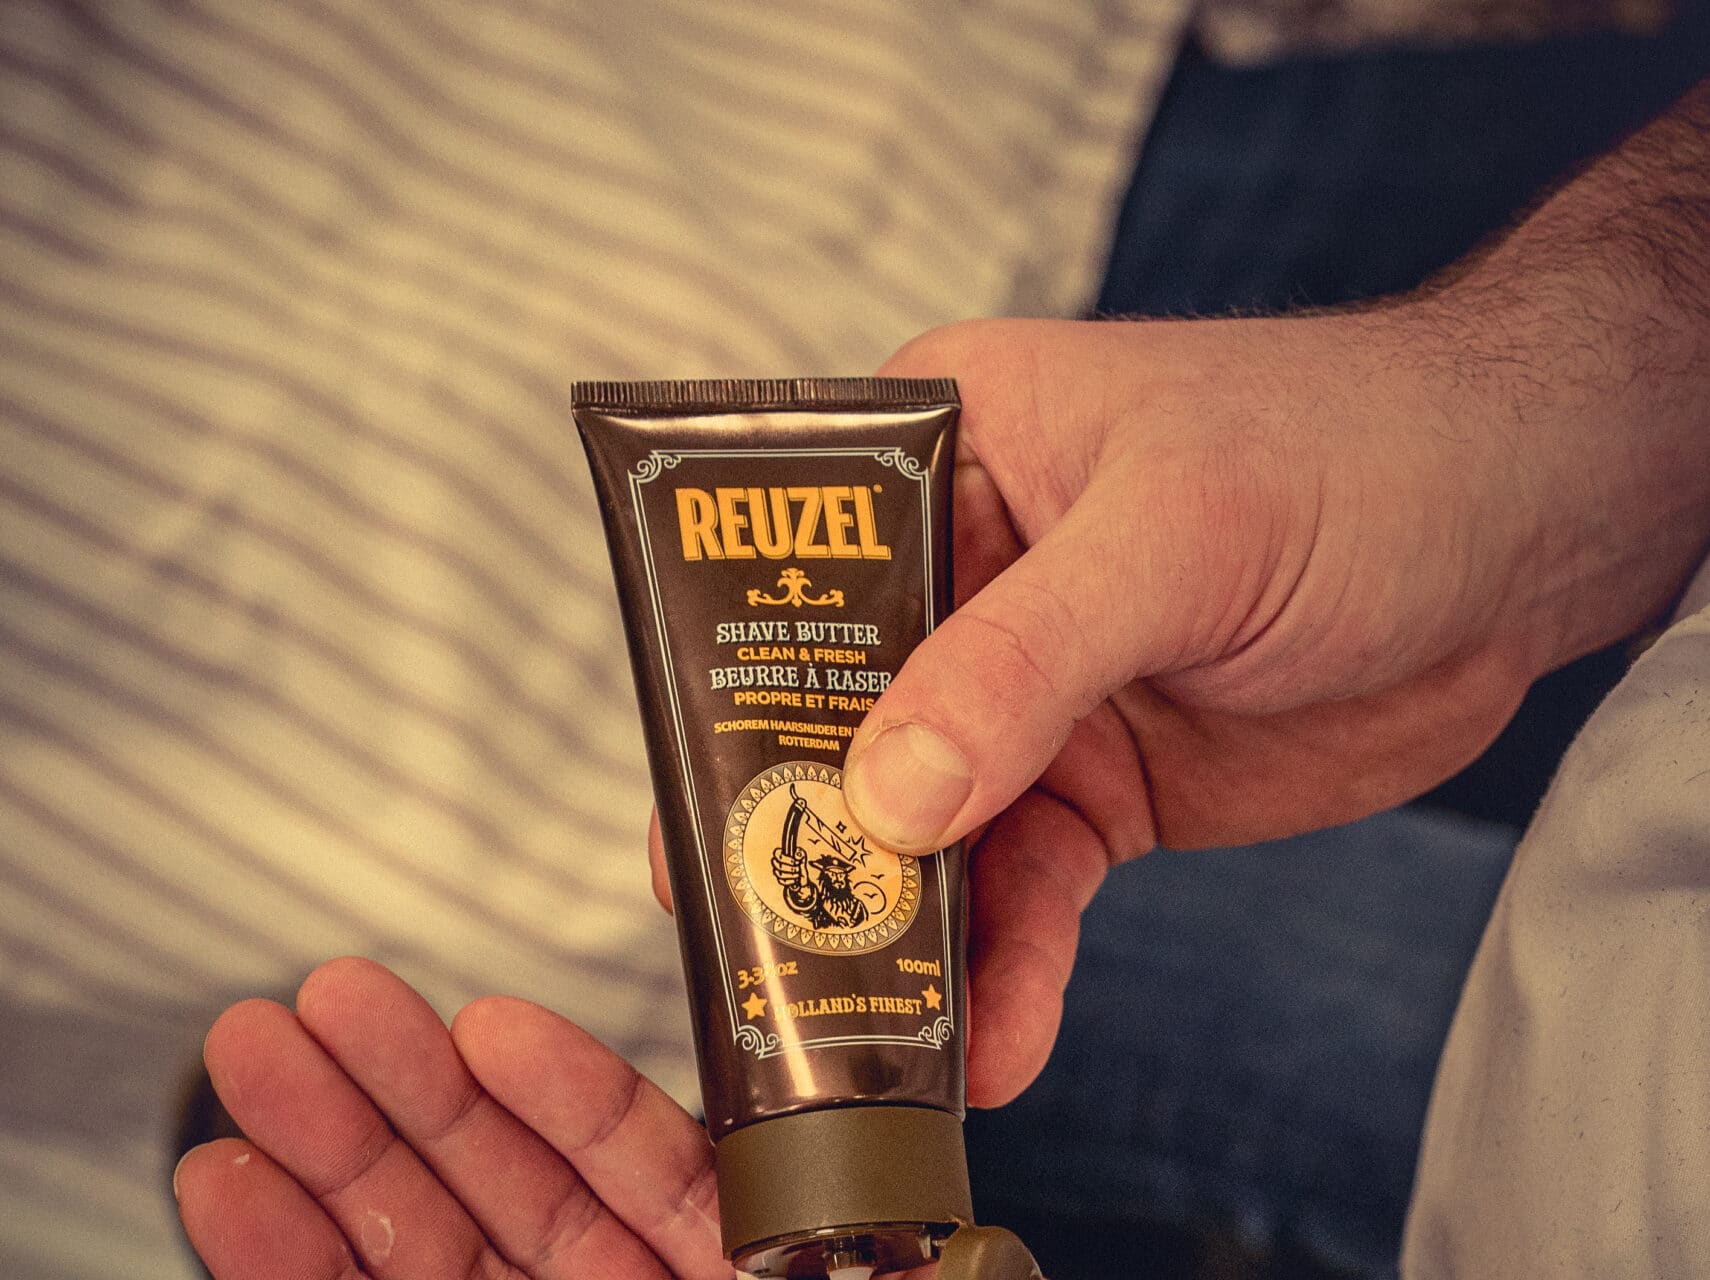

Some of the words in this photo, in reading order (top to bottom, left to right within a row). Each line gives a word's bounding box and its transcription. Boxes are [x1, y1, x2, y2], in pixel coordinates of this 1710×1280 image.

[675, 486, 892, 561] REUZEL
[717, 621, 791, 645] SHAVE
[795, 621, 881, 646] BUTTER
[736, 647, 795, 661] CLEAN
[799, 648, 811, 662] &
[814, 649, 866, 665] FRESH
[709, 666, 799, 691] BEURRE
[805, 663, 821, 689] À
[826, 669, 892, 693] RASER
[734, 692, 802, 707] PROPRE
[805, 694, 825, 708] ET
[828, 695, 875, 712] FRAIS
[714, 720, 769, 734] SCHOREM
[838, 726, 853, 738] EN
[779, 735, 840, 751] ROTTERDAM
[896, 957, 941, 977] 100ml
[774, 993, 866, 1021] OLLAND'S
[869, 996, 923, 1015] FINEST
